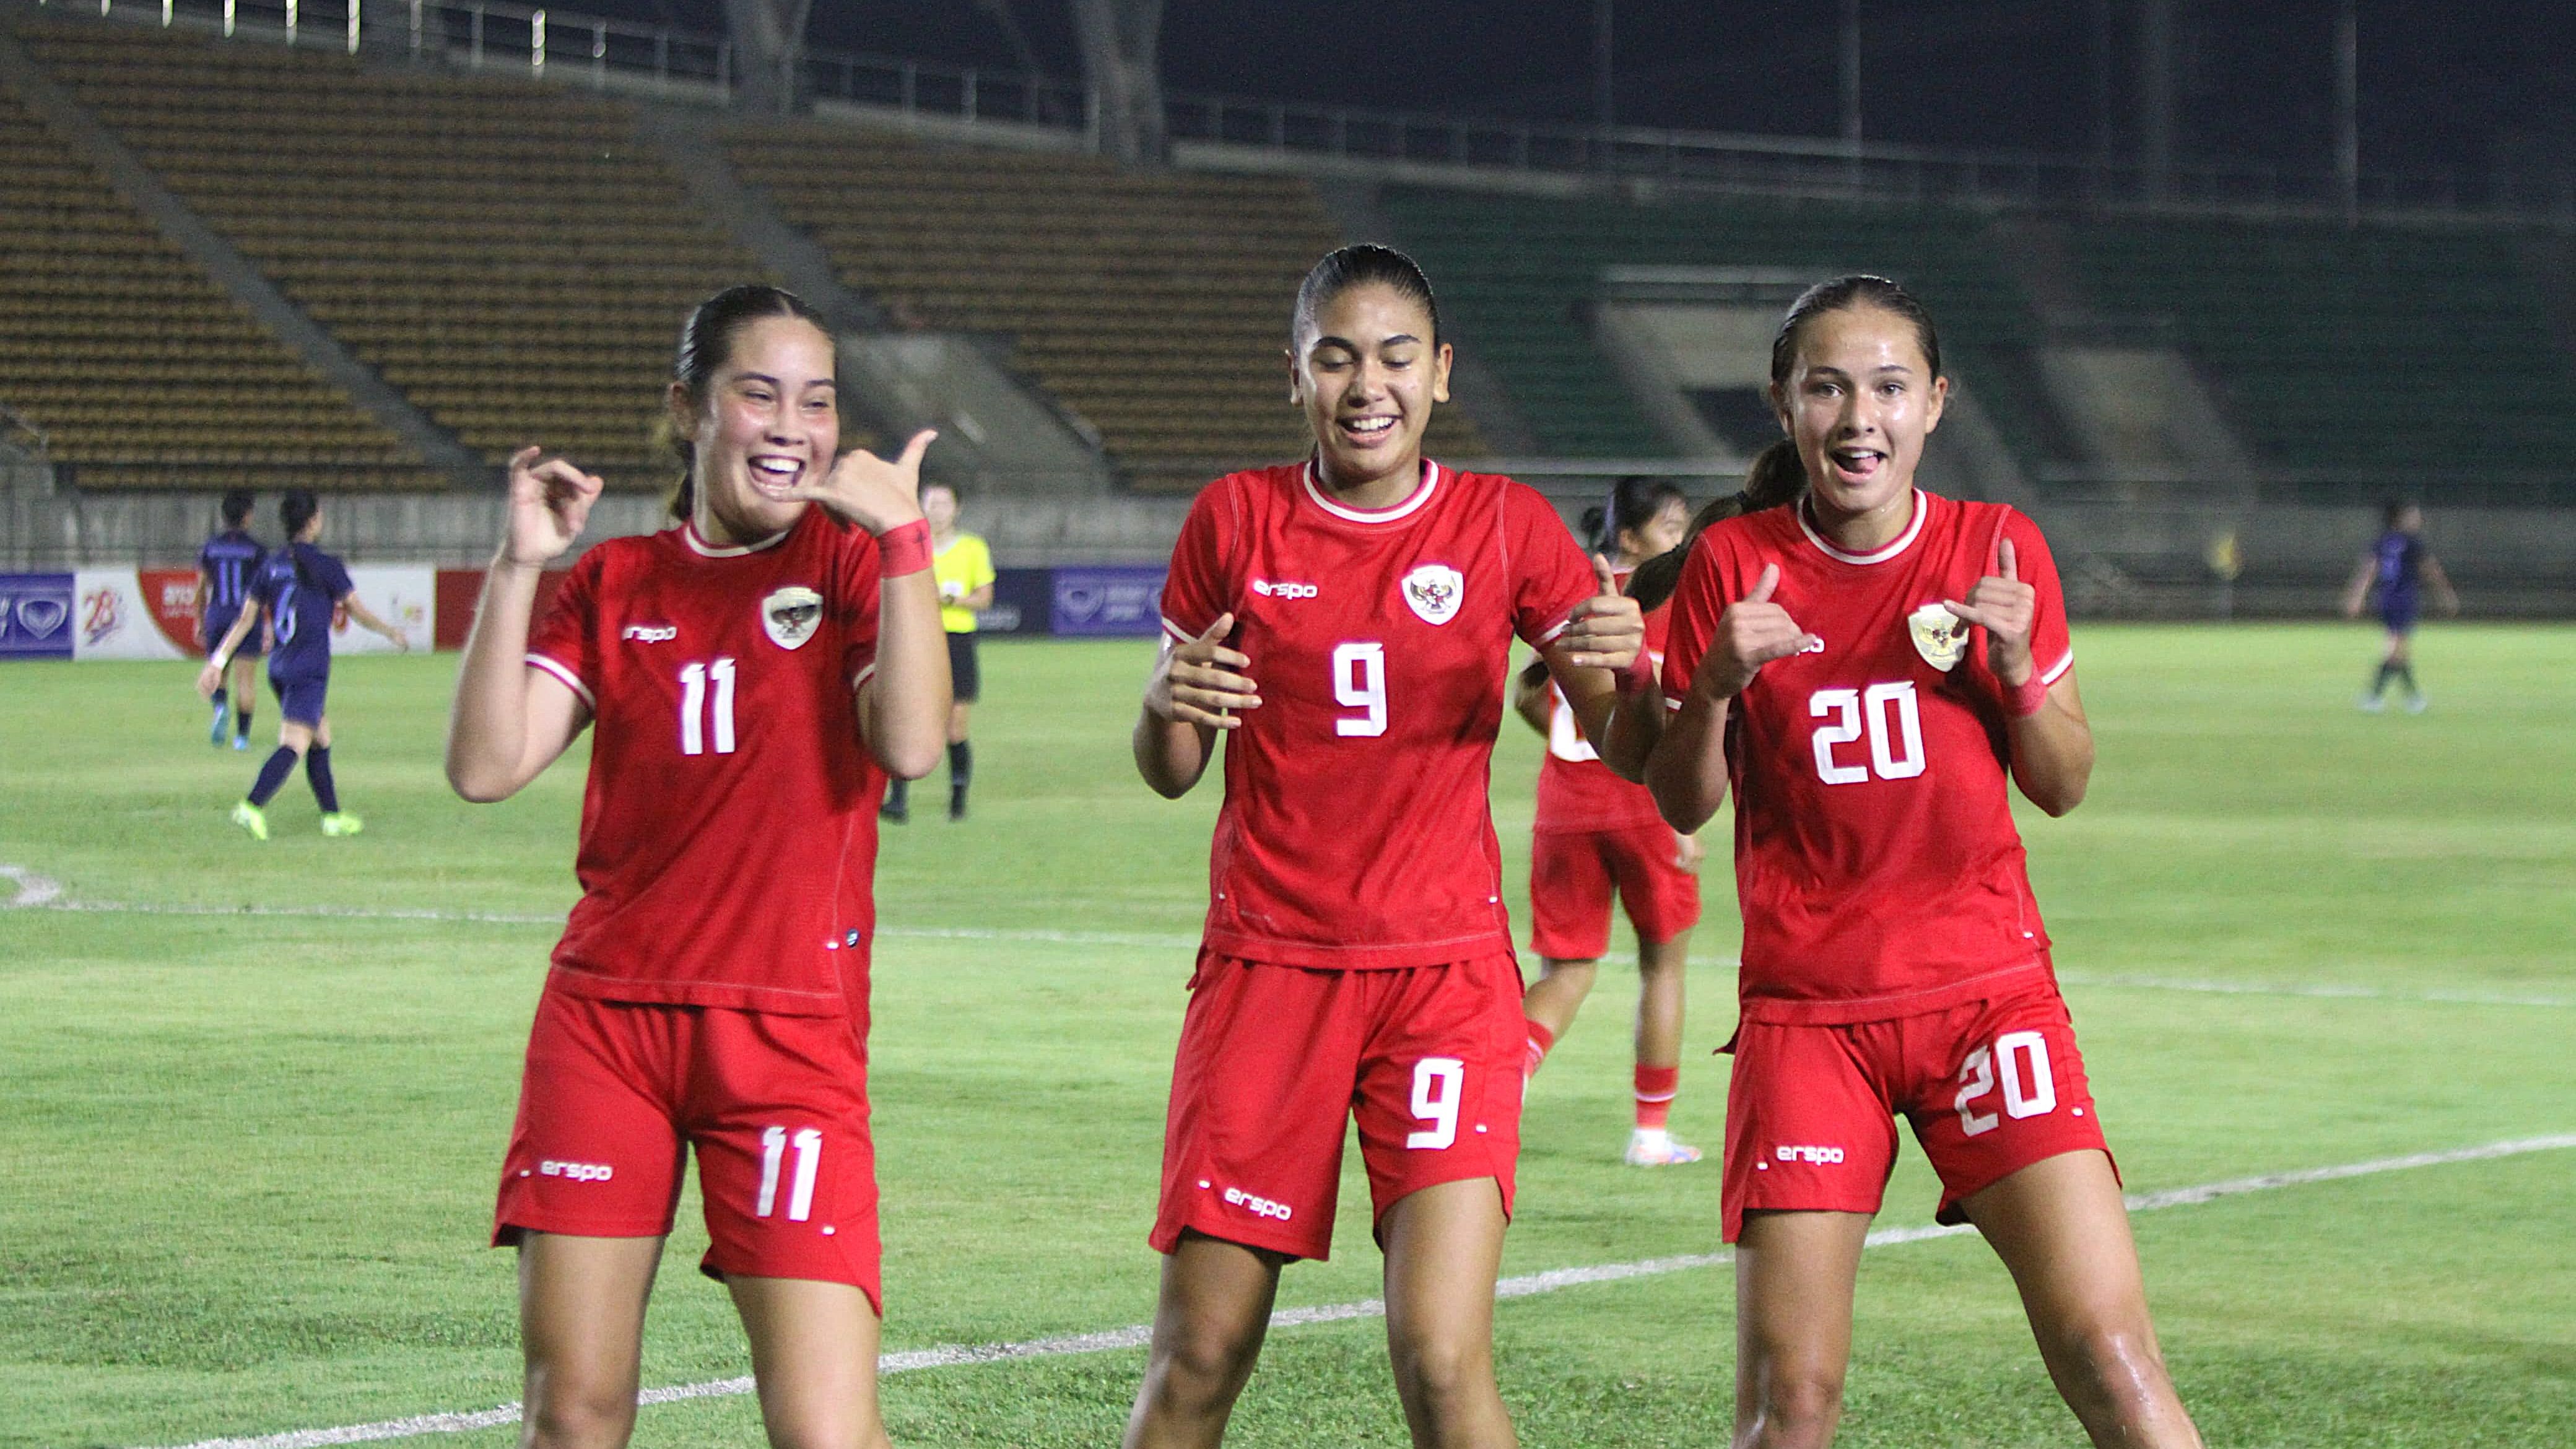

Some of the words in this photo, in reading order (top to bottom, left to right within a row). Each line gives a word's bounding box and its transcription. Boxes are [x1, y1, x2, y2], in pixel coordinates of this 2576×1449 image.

[1253, 579, 1318, 600] erspo
[680, 658, 736, 755] 11
[1333, 642, 1387, 736] 9
[1809, 681, 1926, 785] 20
[1406, 1057, 1464, 1149] 9
[1954, 1030, 2057, 1137] 20
[541, 1160, 612, 1182] erspo
[757, 1126, 822, 1222] 11
[1777, 1146, 1844, 1165] erspo
[1225, 1187, 1292, 1221] erspo
